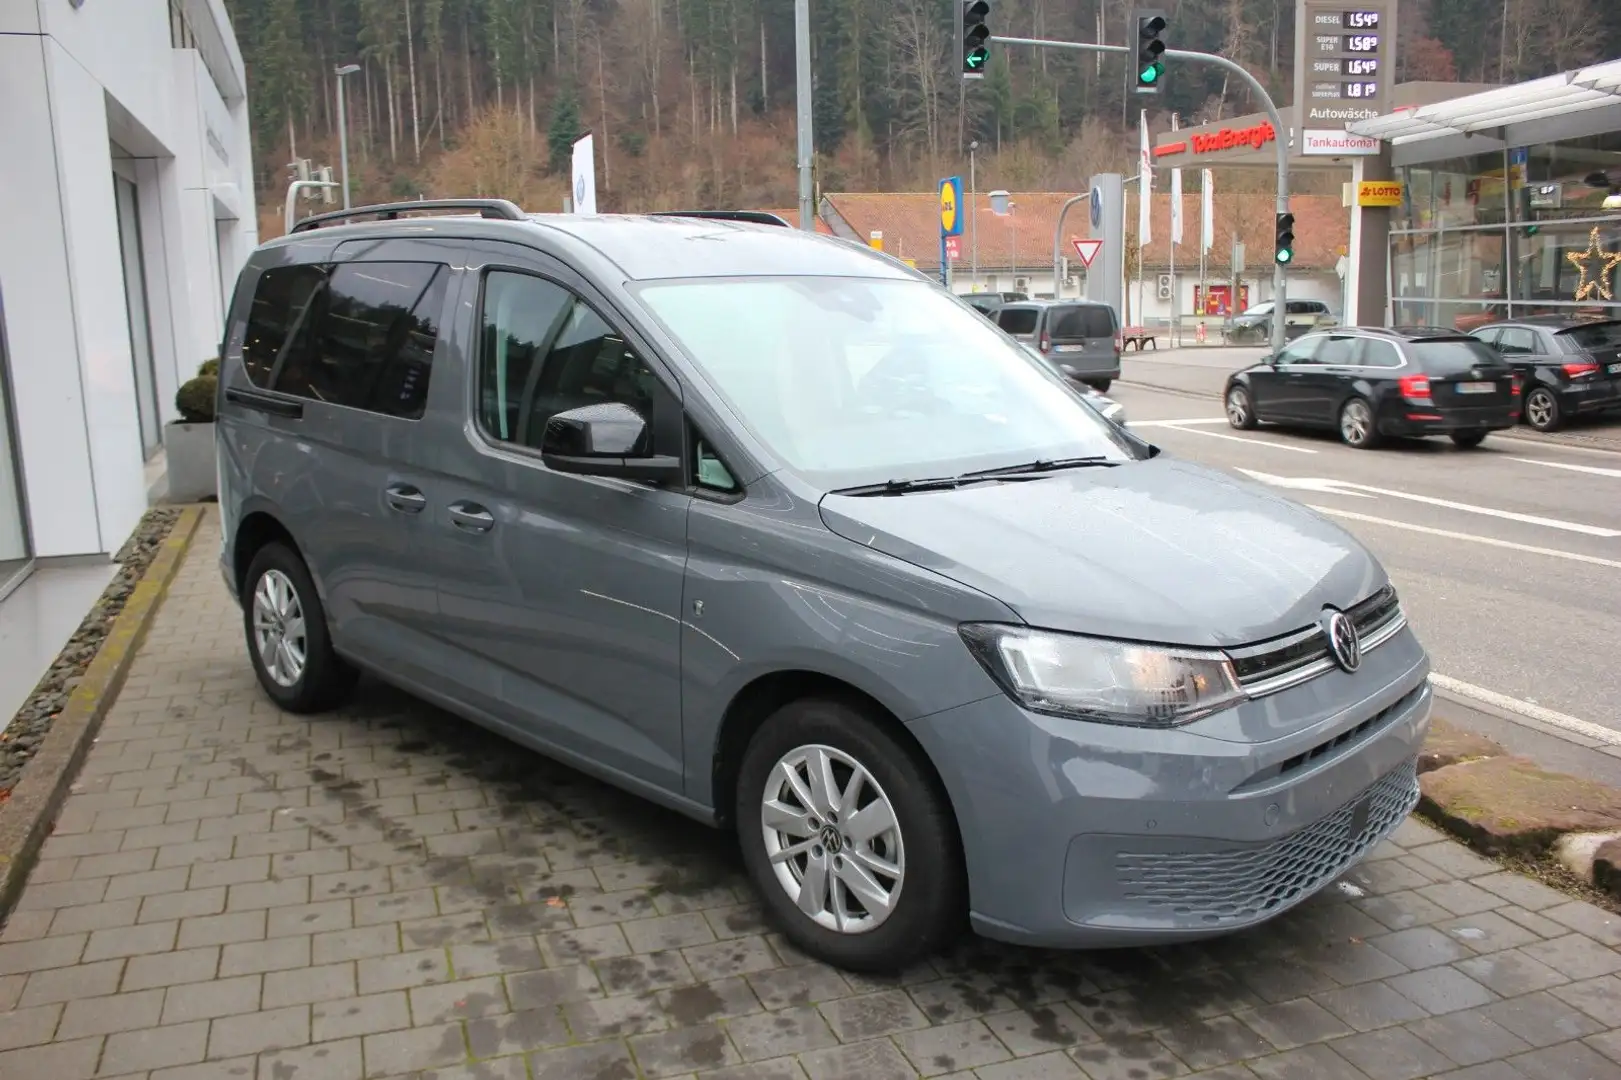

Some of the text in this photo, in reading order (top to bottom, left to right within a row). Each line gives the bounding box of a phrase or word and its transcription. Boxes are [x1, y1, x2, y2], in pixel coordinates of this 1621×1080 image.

[1315, 15, 1341, 24] DIESEL
[1316, 36, 1338, 44] SUPER
[1314, 62, 1340, 72] SUPER
[1310, 108, 1378, 119] Autowäsche
[1191, 121, 1275, 153] TotalEnergie
[1307, 137, 1376, 148] Tankautomat
[1372, 187, 1400, 196] LOTTO
